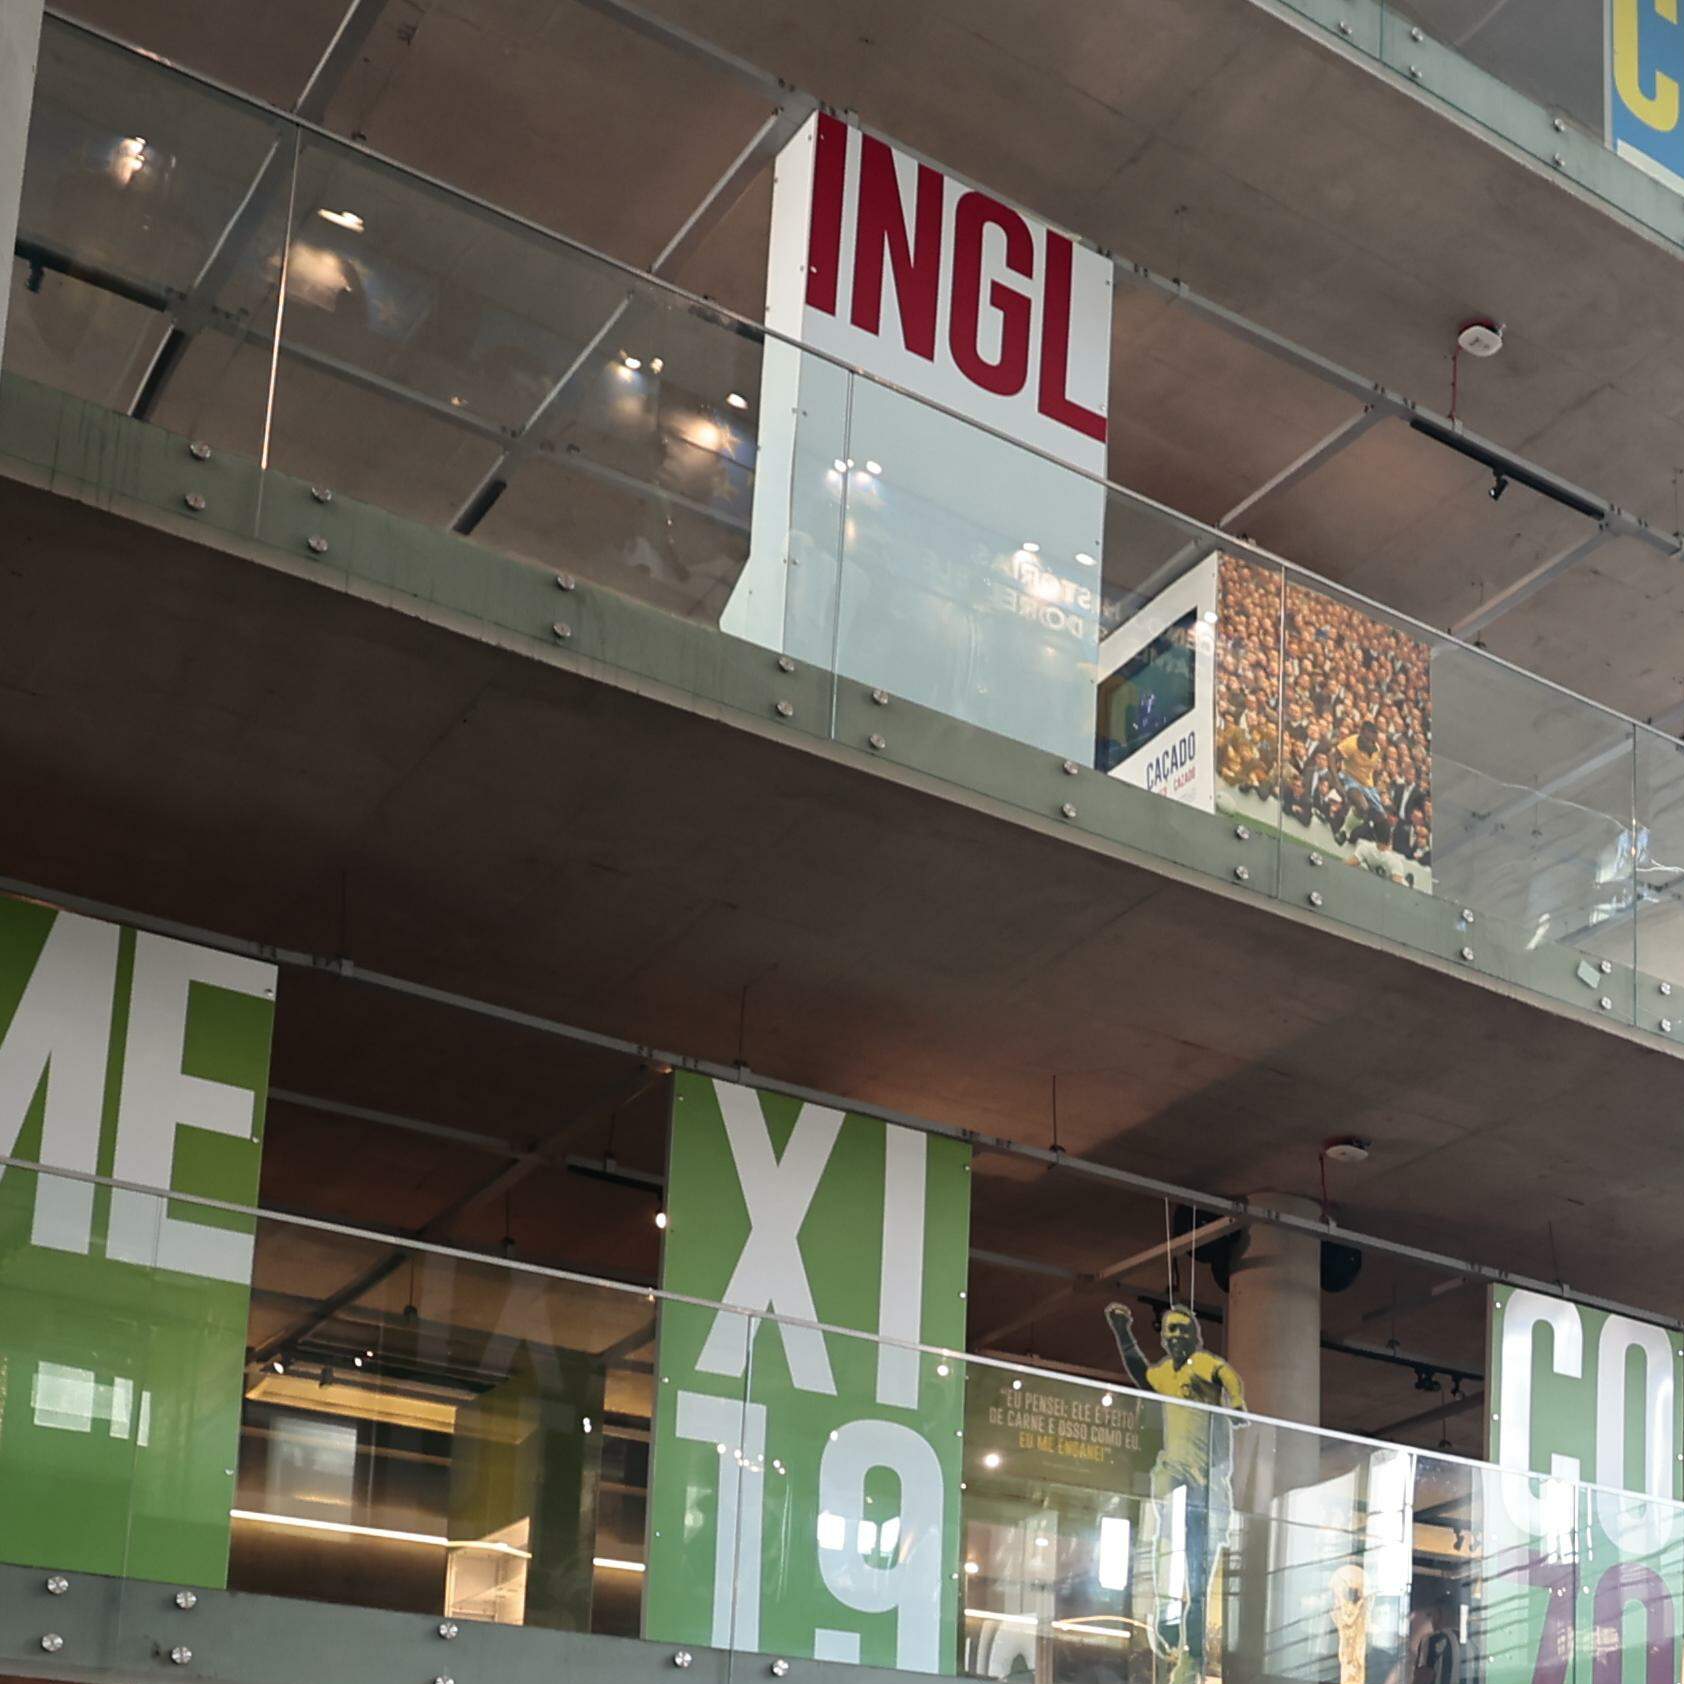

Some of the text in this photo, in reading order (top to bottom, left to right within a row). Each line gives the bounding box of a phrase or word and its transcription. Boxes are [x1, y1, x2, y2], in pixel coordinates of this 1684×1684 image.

[805, 110, 1107, 443] INGL
[1146, 731, 1196, 790] CAÇADO
[694, 1077, 928, 1410] XI
[988, 1406, 1004, 1425] DE
[1007, 1410, 1046, 1433] CARNE
[1048, 1416, 1055, 1434] E
[1057, 1418, 1088, 1440] OSSO
[1091, 1425, 1122, 1447] COMO
[1018, 1431, 1033, 1449] EU
[1072, 1401, 1091, 1422] ELE
[1500, 1287, 1674, 1557] CO
[675, 1391, 959, 1675] 19
